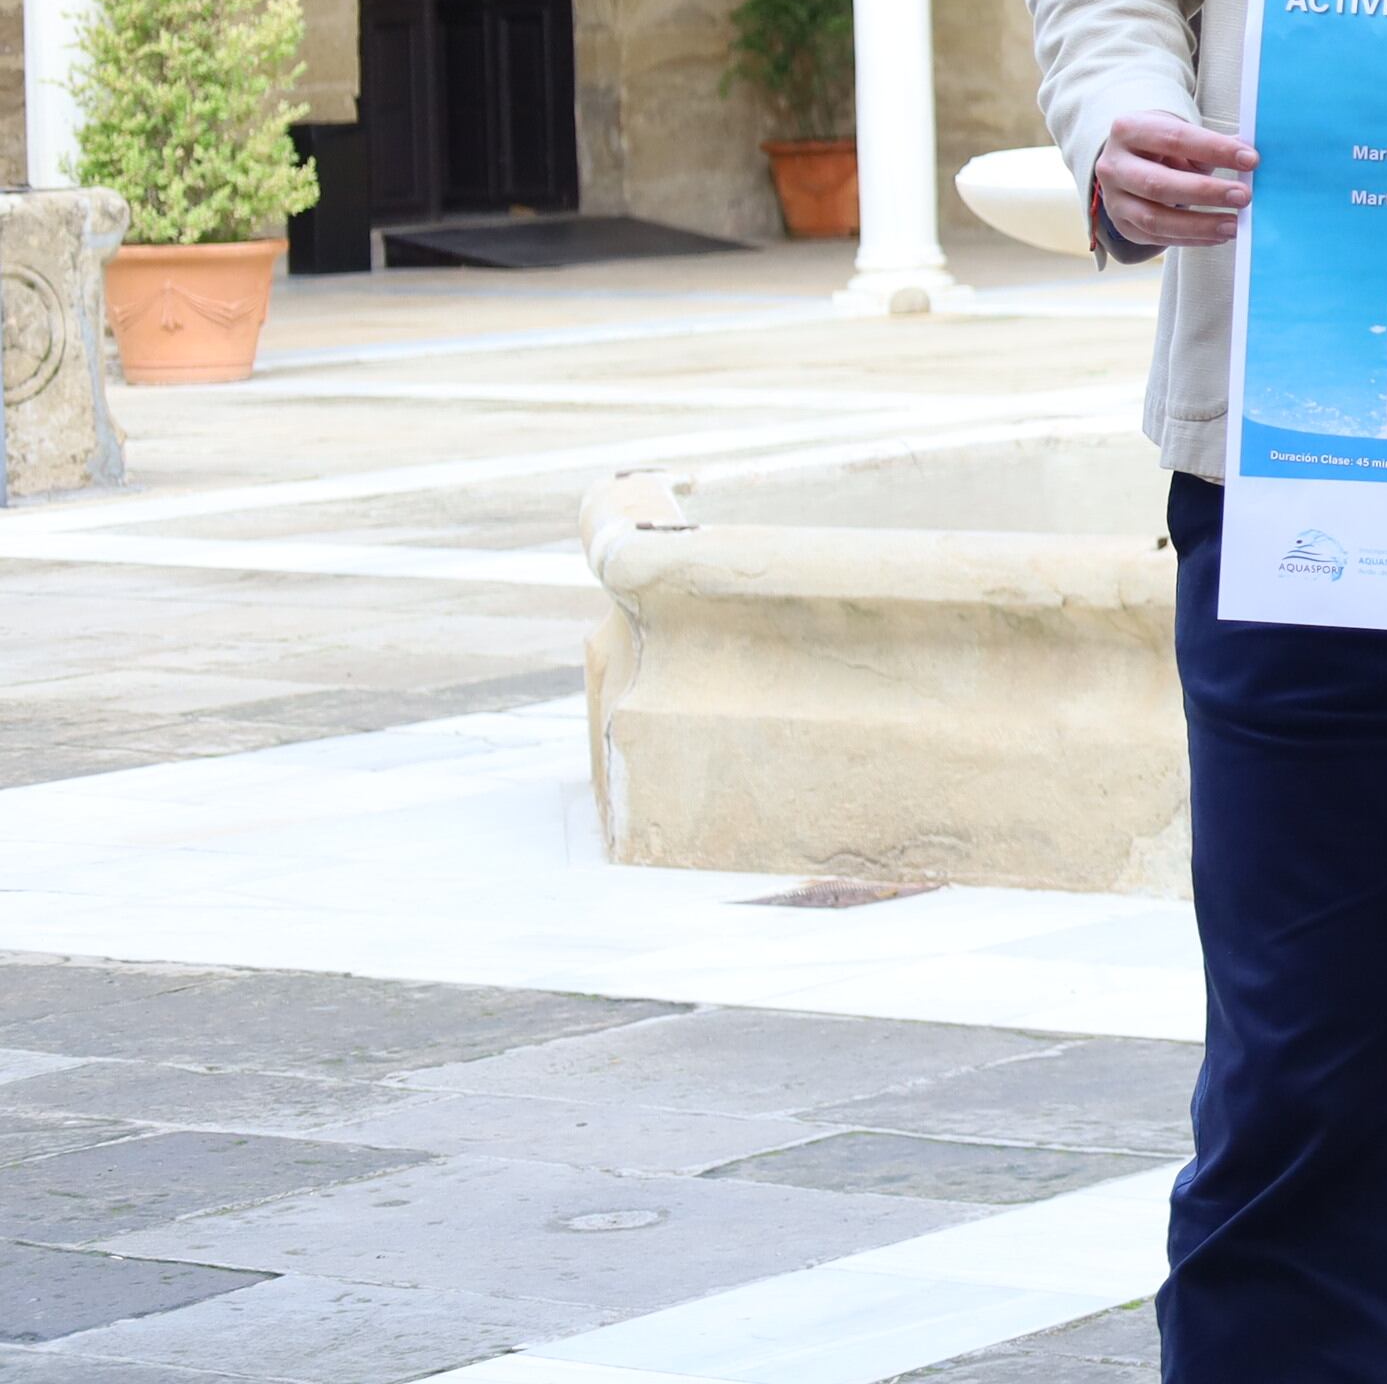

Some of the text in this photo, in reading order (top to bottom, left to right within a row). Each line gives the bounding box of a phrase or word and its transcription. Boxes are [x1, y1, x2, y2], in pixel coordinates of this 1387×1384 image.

[1270, 450, 1318, 463] Duración
[1320, 454, 1353, 466] Clase:
[1356, 457, 1369, 467] 45
[1278, 563, 1344, 575] AQUASPORT
